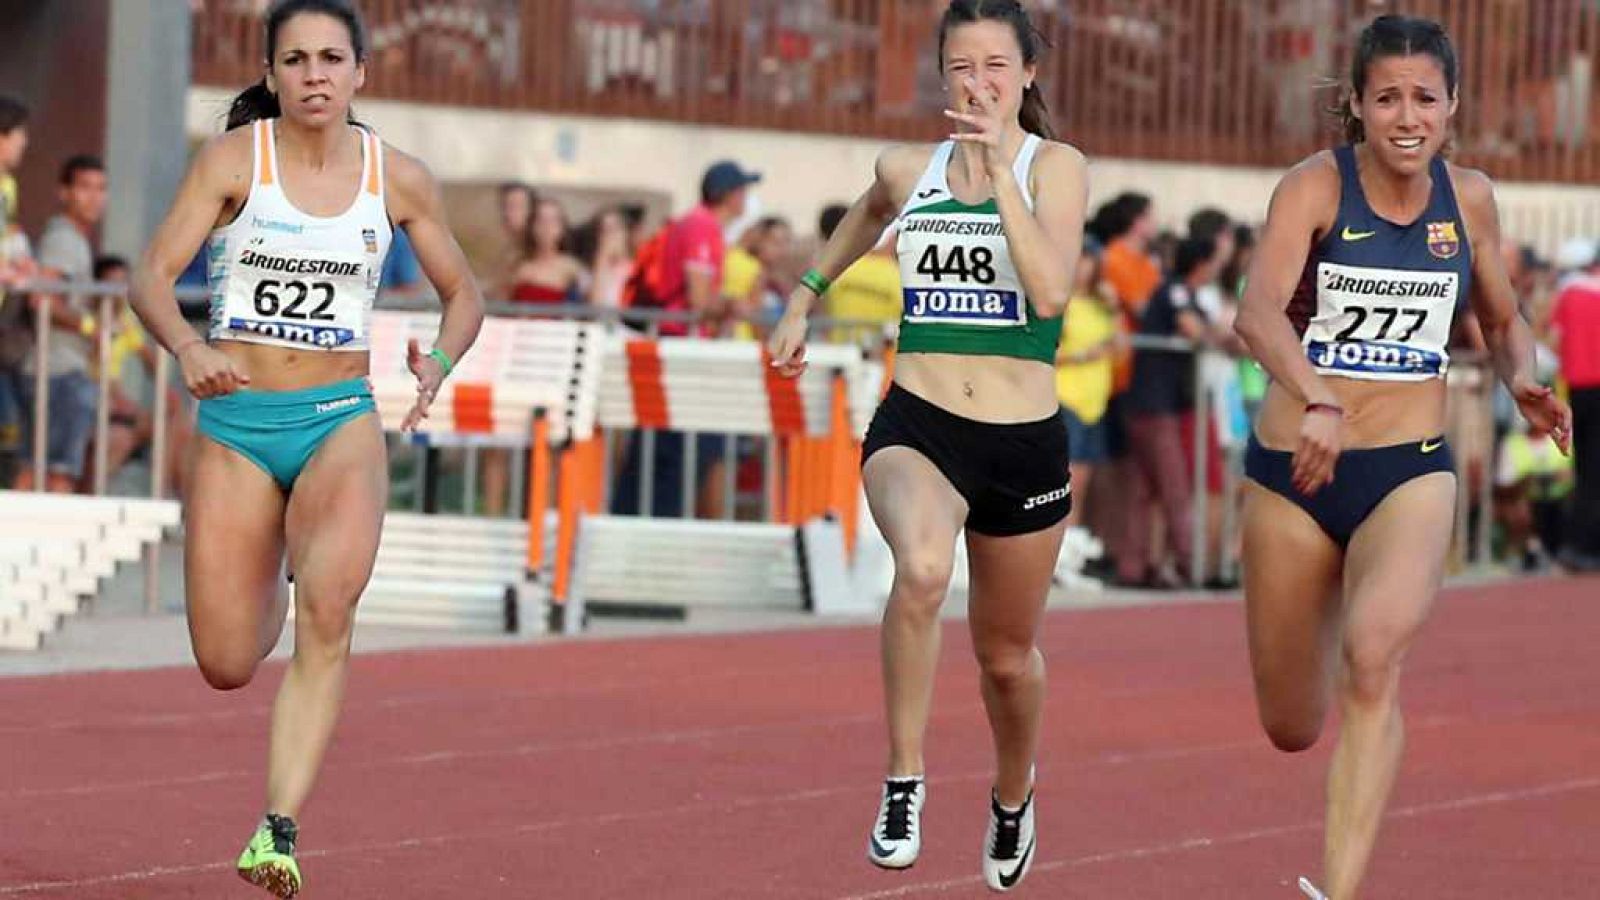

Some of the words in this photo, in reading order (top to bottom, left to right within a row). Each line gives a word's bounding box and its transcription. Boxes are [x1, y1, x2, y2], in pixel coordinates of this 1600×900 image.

[904, 218, 1007, 236] BRIDGESTON
[239, 249, 362, 276] BRIDGESTONE
[916, 244, 996, 284] 448
[254, 279, 335, 321] 622
[1326, 273, 1450, 298] BRIDGESTONE
[1334, 305, 1428, 342] 277
